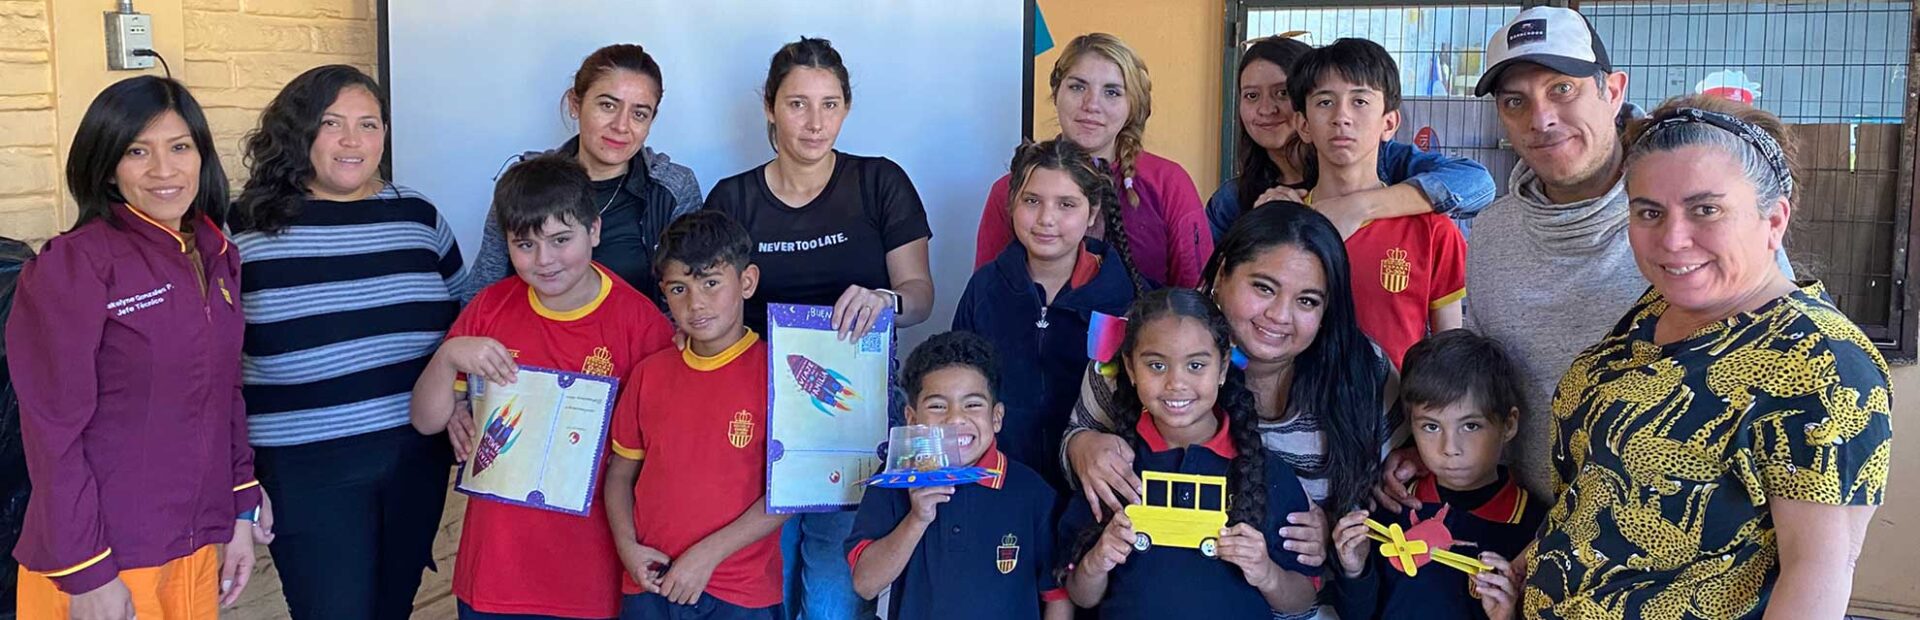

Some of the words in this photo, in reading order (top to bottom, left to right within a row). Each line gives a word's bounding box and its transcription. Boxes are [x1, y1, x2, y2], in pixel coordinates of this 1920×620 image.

[758, 242, 795, 252] NEVER
[796, 240, 818, 251] TOO
[818, 233, 848, 247] LATE.
